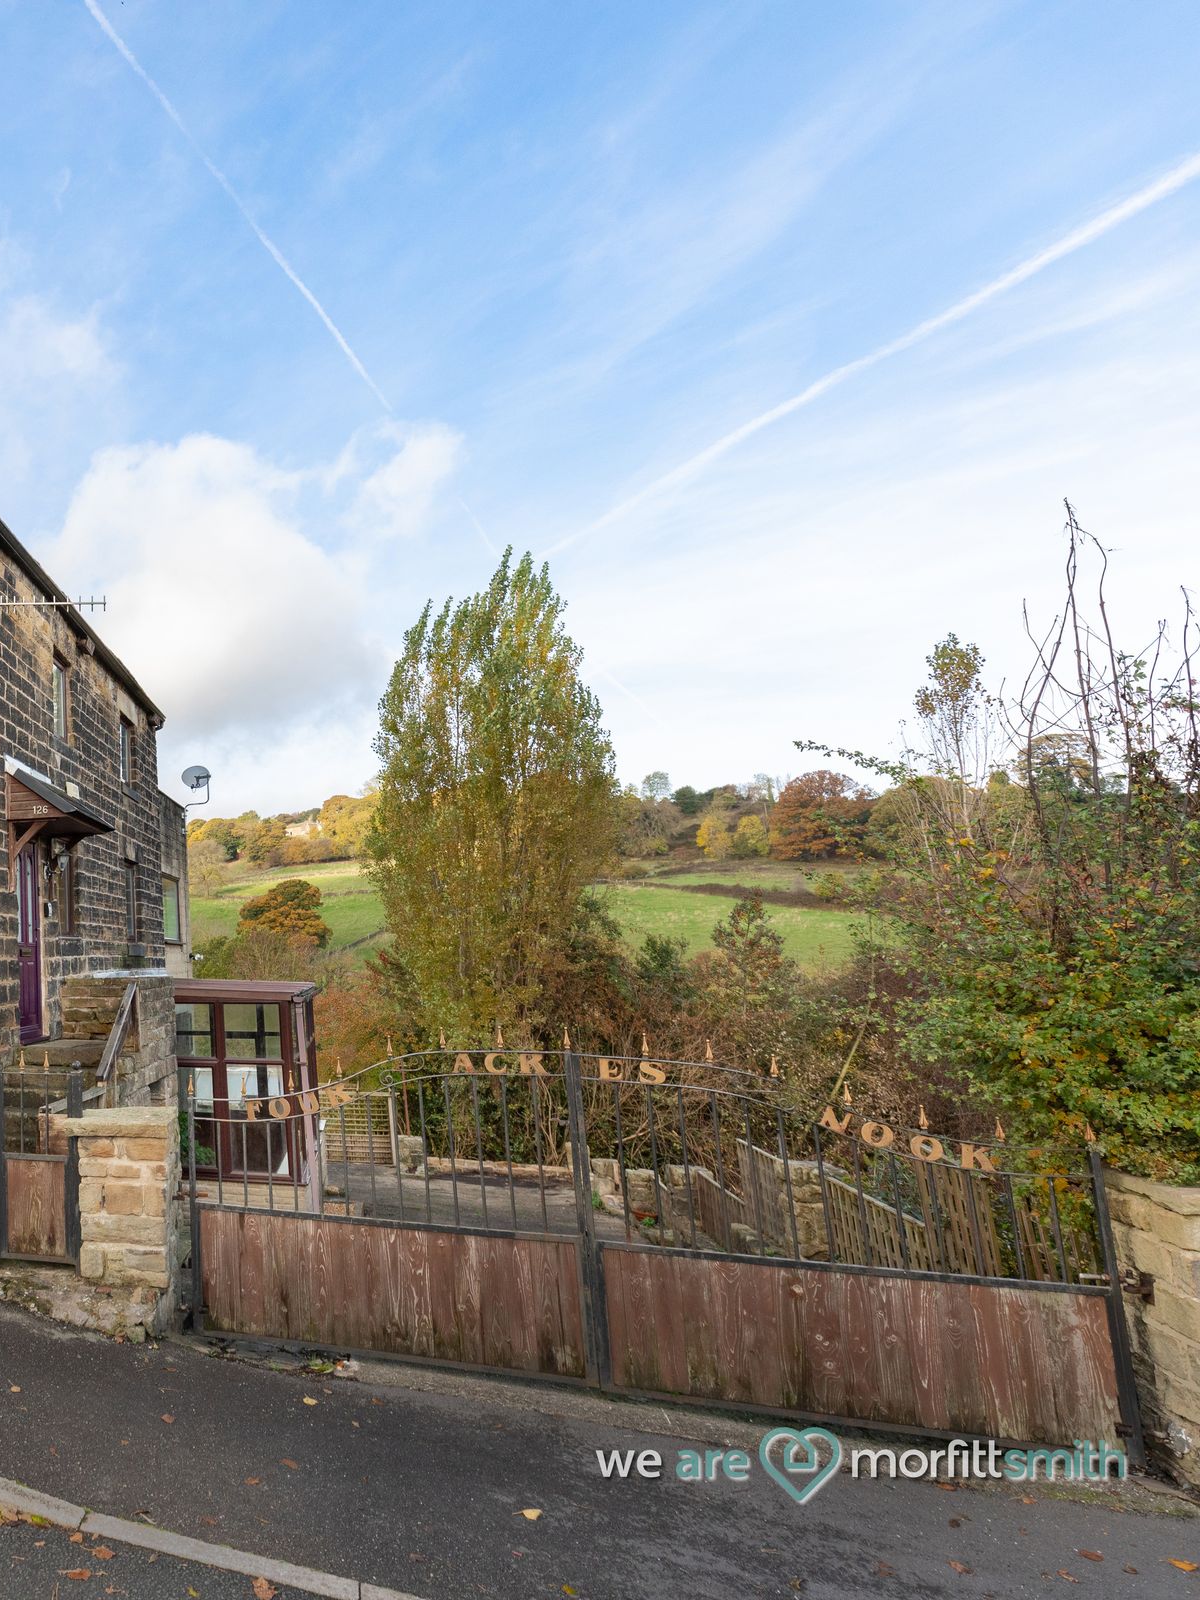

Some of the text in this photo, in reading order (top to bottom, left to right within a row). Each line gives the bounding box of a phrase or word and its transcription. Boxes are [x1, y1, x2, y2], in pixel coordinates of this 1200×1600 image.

[32, 805, 49, 815] 126
[245, 1052, 997, 1172] FOUR ACRES NOOK
